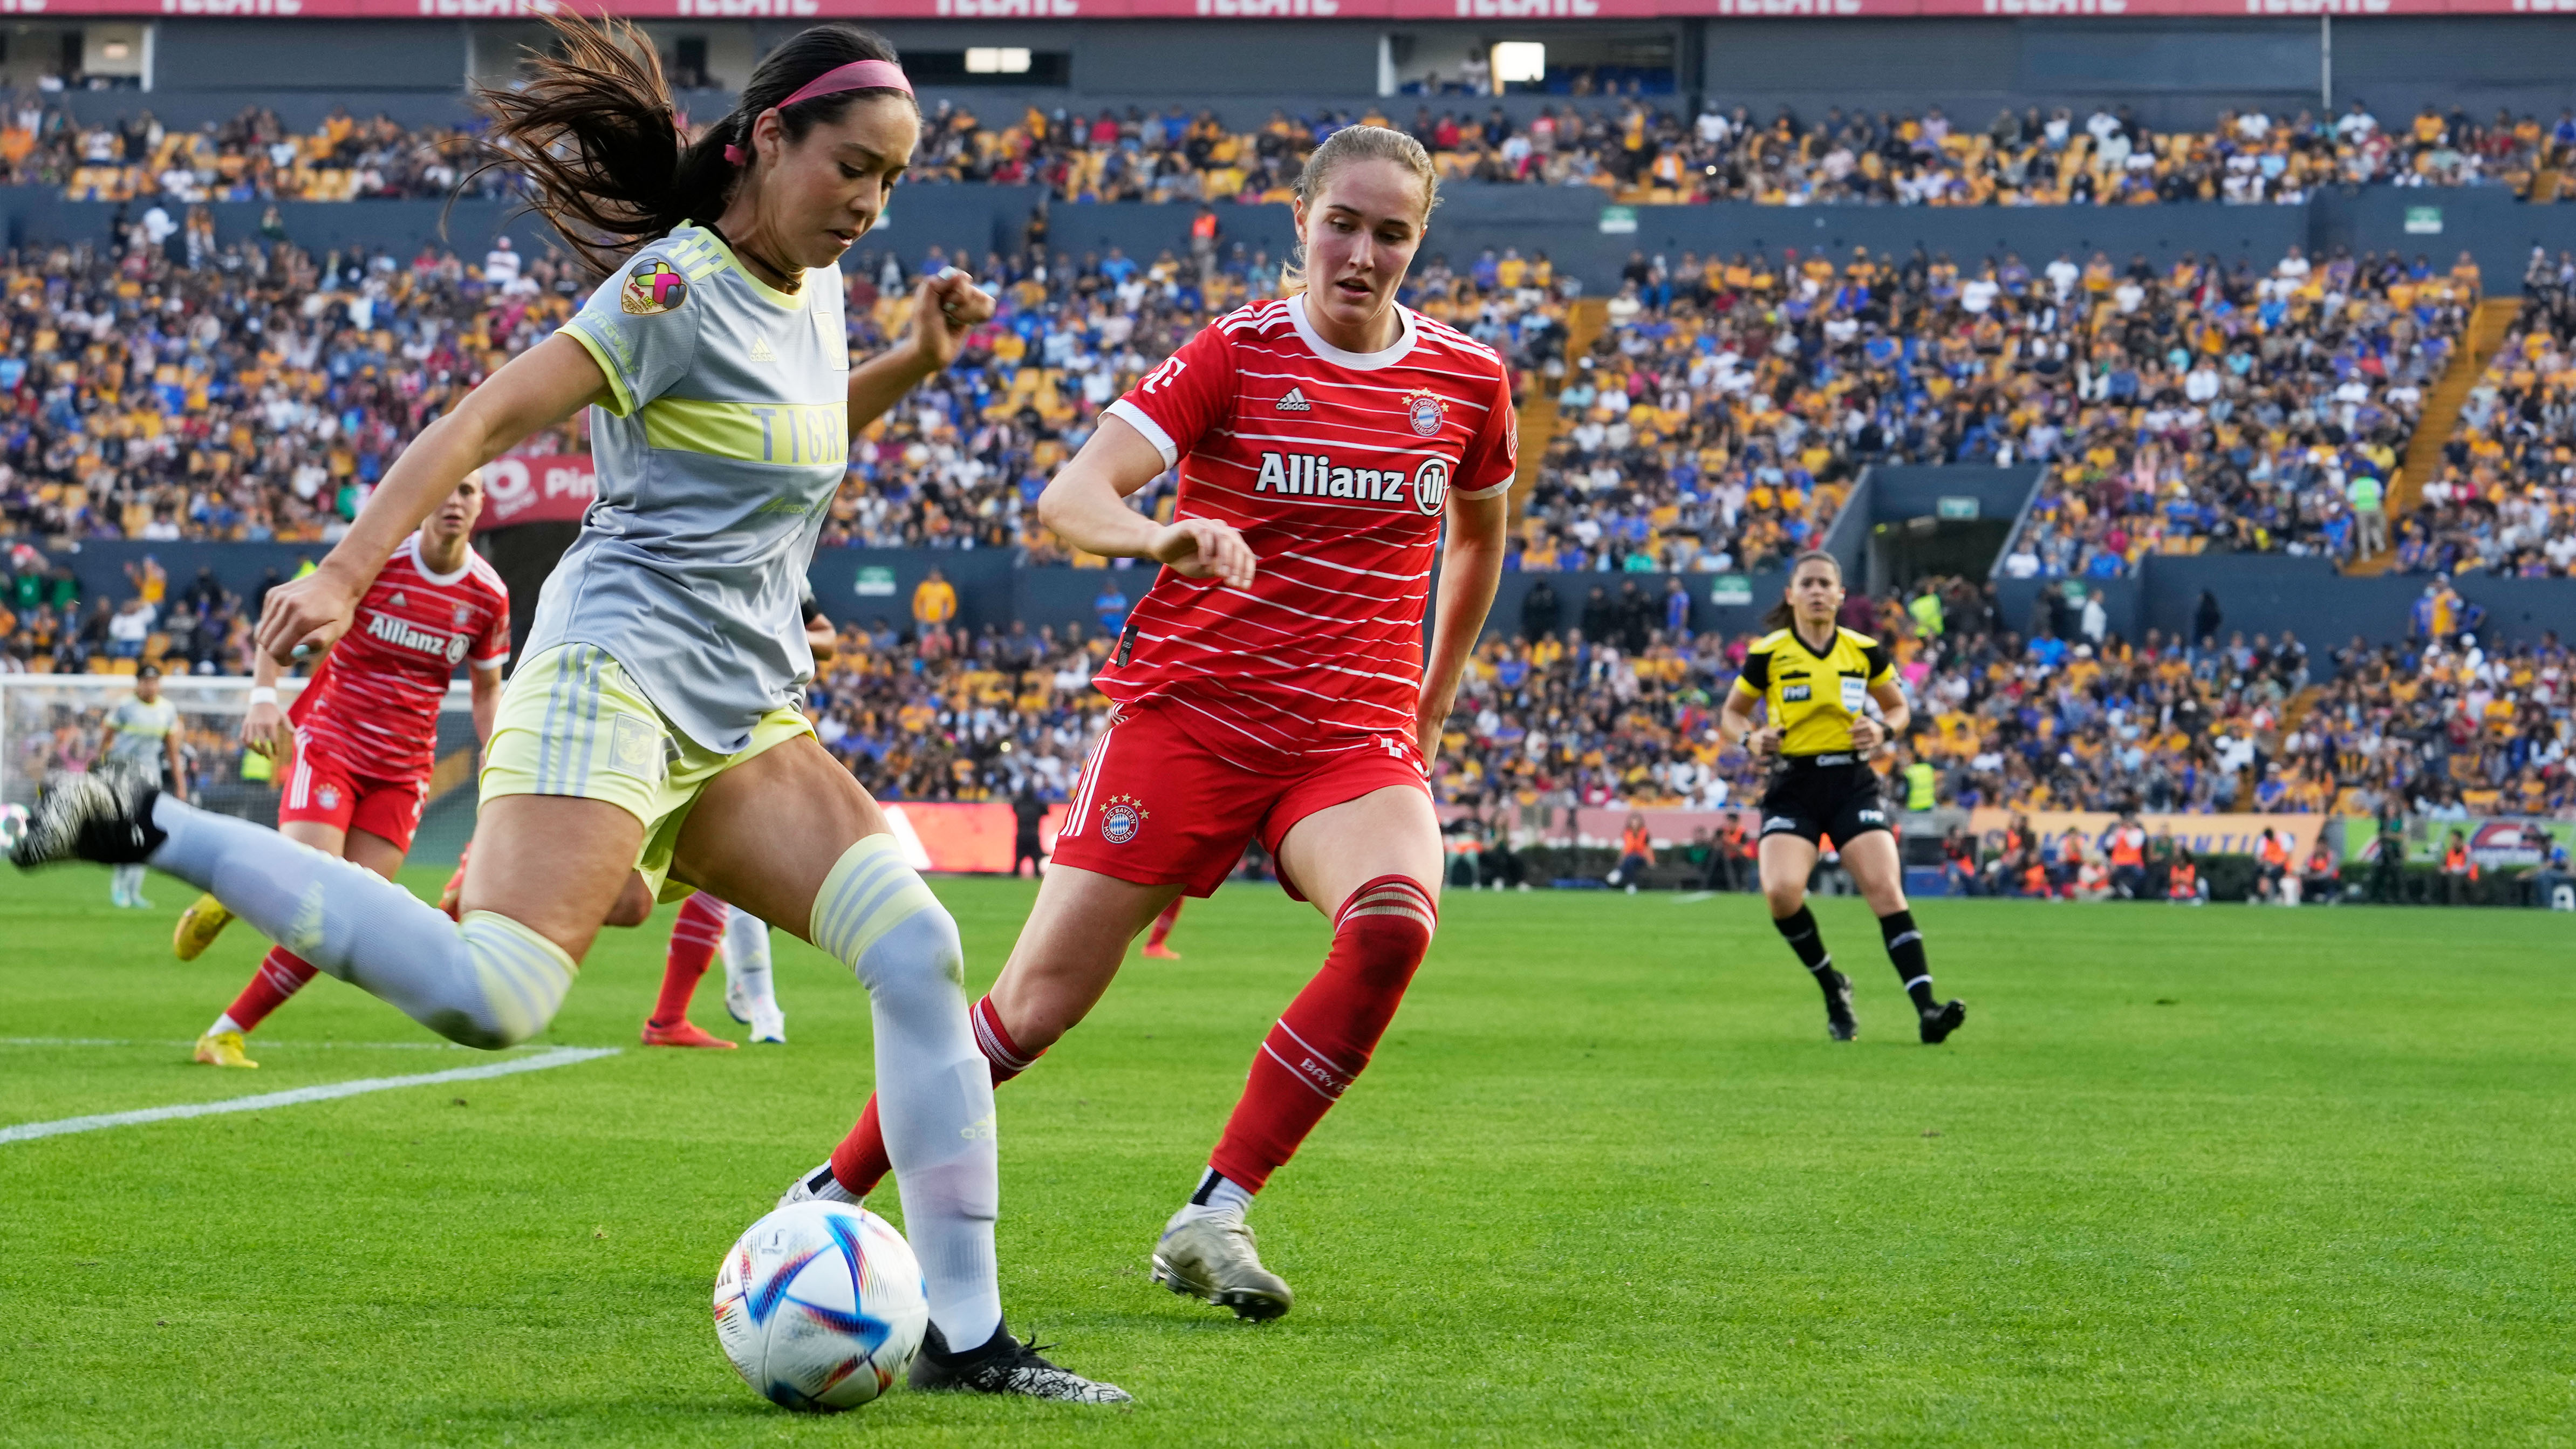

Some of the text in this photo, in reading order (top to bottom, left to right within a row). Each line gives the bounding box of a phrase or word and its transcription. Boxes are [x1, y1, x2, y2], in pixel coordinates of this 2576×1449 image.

[750, 353, 777, 362] adidas
[1275, 401, 1311, 411] adidas
[1254, 452, 1405, 502] Allianz
[366, 614, 445, 655] Allianz
[1106, 808, 1136, 824] FC BAYERN
